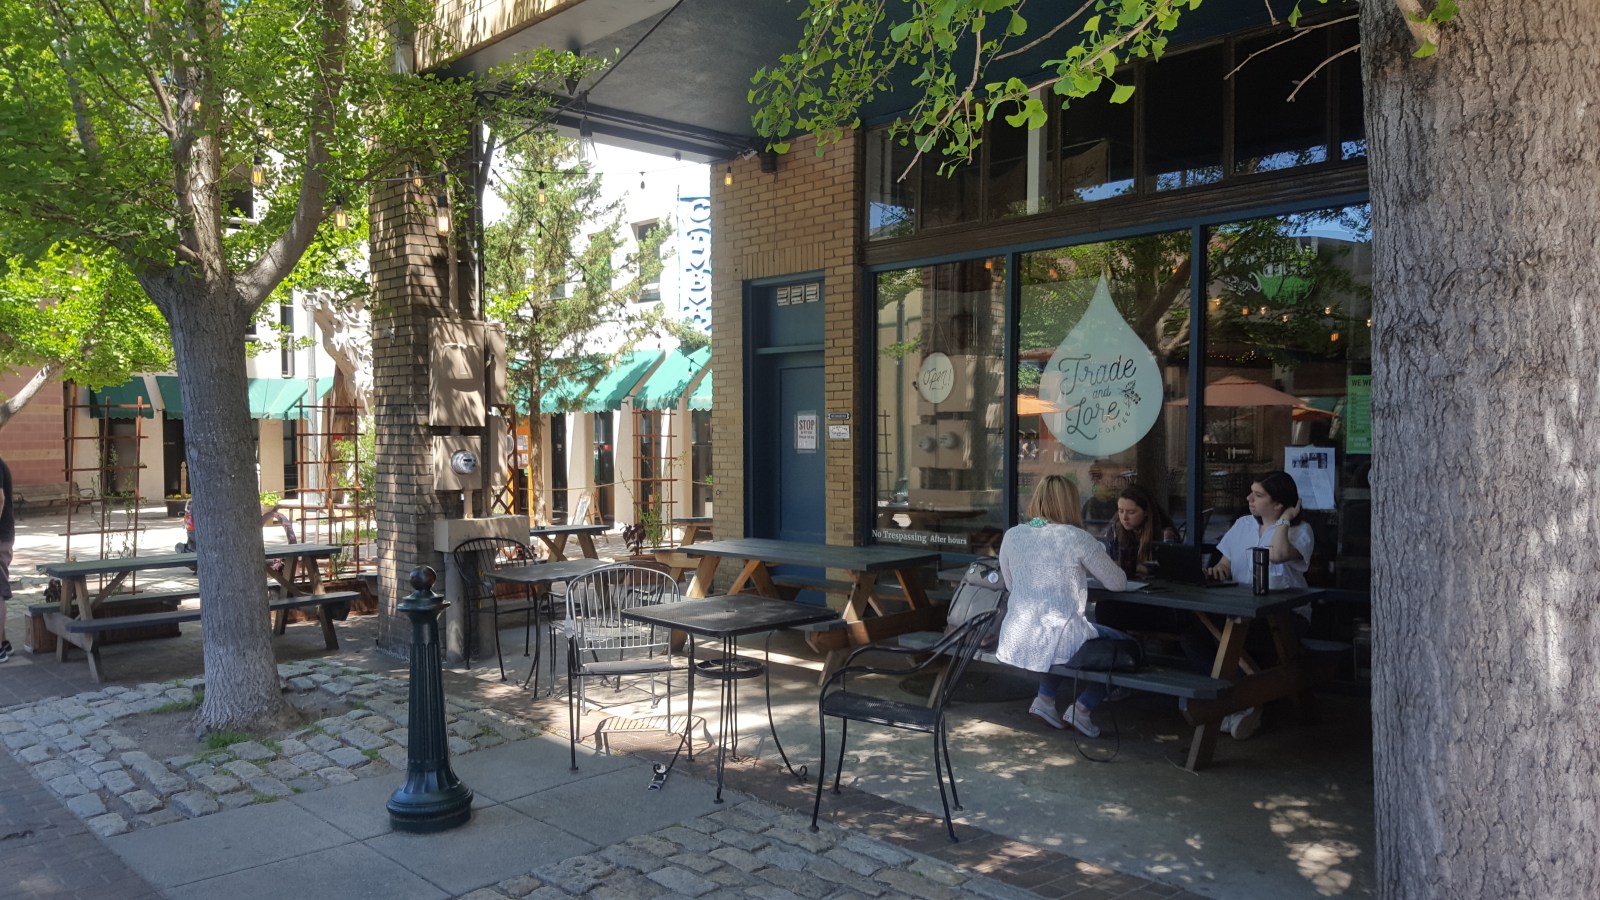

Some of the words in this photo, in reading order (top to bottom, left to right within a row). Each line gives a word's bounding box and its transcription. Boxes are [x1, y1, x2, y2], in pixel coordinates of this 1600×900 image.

[1058, 353, 1137, 395] Trade
[1352, 379, 1361, 387] WE
[1092, 386, 1112, 399] and
[799, 419, 815, 430] STOP
[1065, 397, 1120, 441] Lore
[1098, 411, 1131, 434] COFFEE
[872, 529, 882, 538] No
[883, 530, 927, 544] Trespassing
[930, 535, 947, 543] After
[948, 535, 967, 545] hours
